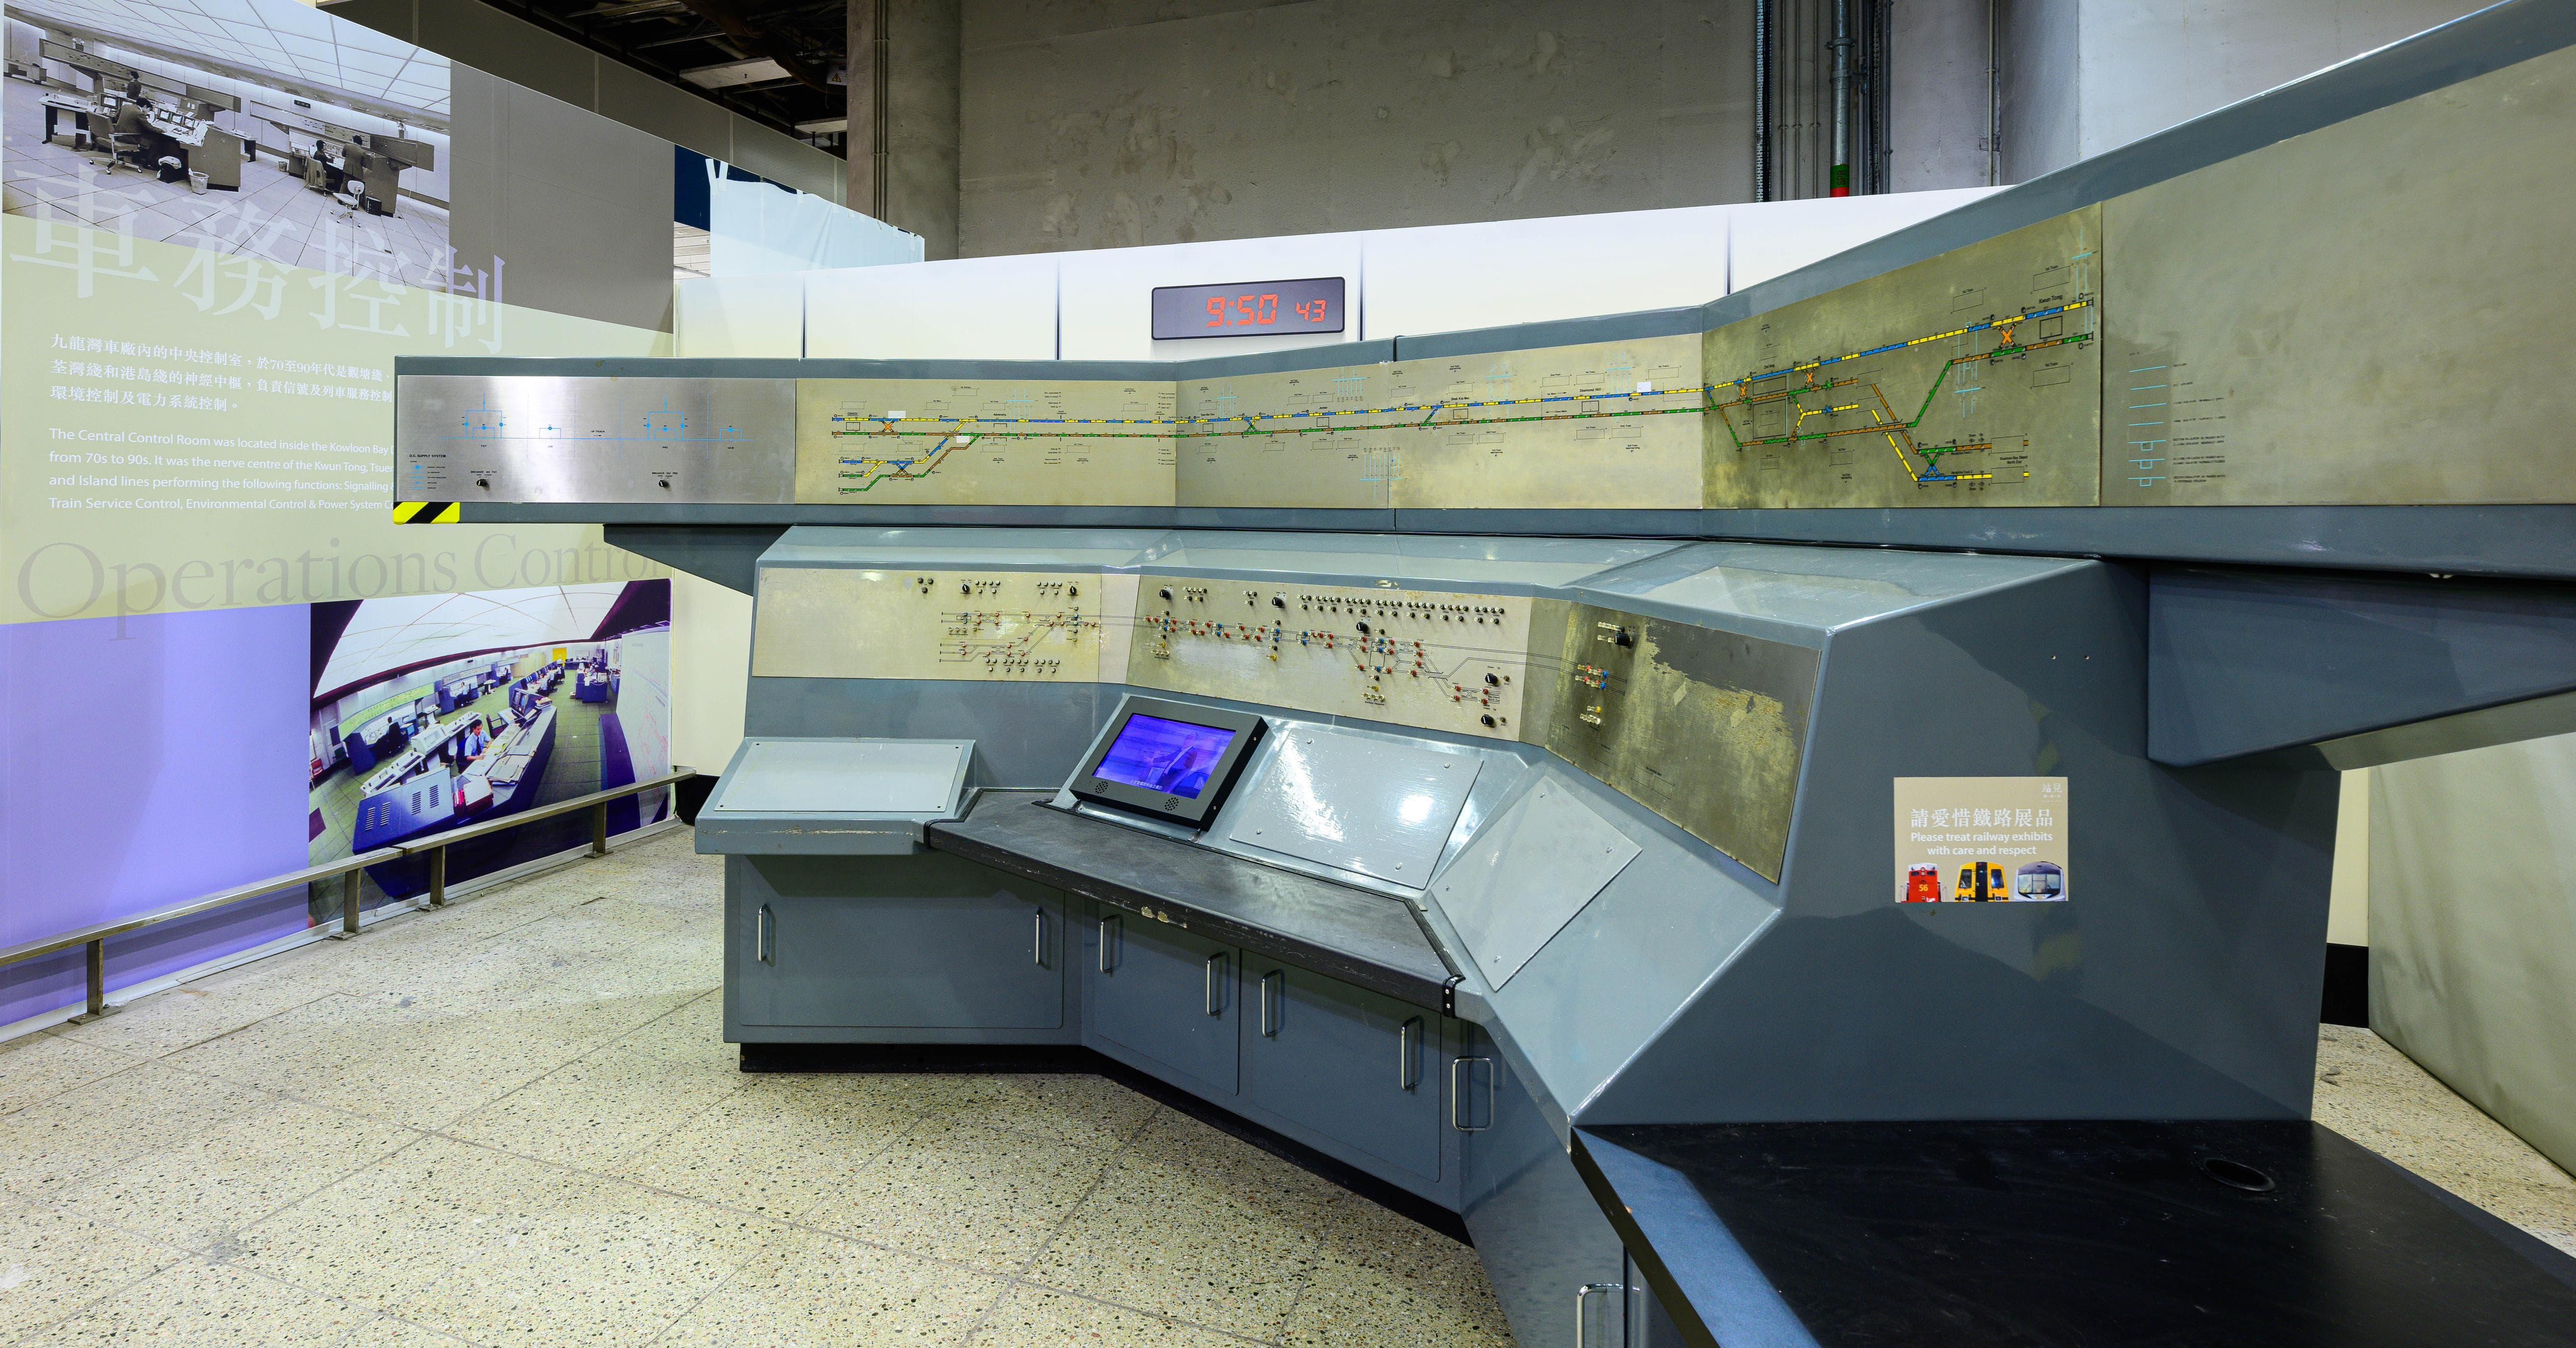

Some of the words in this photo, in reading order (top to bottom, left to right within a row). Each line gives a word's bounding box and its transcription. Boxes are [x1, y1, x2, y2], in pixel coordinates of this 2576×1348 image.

[9, 162, 506, 354] 車務控制
[1207, 294, 1278, 327] 9:50
[1296, 300, 1326, 322] 43
[50, 385, 238, 411] 環境控制及電力系統控制。
[50, 428, 74, 440] The
[78, 430, 124, 442] Central
[128, 432, 173, 444] Control
[177, 435, 210, 446] Room
[213, 439, 234, 447] was
[238, 438, 277, 449] located
[280, 440, 309, 451] inside
[311, 442, 328, 452] the
[330, 443, 370, 453] Kowloon
[373, 444, 388, 456] Bay
[49, 451, 82, 463] from
[86, 453, 108, 464] 70s
[111, 454, 124, 465] to
[128, 454, 151, 465] 90s.
[155, 455, 163, 465] It
[166, 458, 189, 466] was
[192, 456, 210, 467] the
[213, 459, 245, 468] nerve
[248, 460, 280, 469] centre
[283, 460, 294, 470] of
[296, 460, 312, 470] the
[315, 461, 341, 471] Kwun
[344, 462, 368, 474] Tong,
[49, 475, 75, 486] and
[79, 475, 117, 486] Island
[121, 476, 149, 486] lines
[153, 477, 219, 490] performing
[222, 478, 240, 488] the
[243, 478, 291, 491] following
[294, 480, 342, 490] functions:
[344, 481, 388, 492] Signalling
[49, 497, 82, 509] Train
[86, 498, 132, 509] Service
[135, 498, 183, 510] Control,
[186, 498, 266, 509] Environmental
[269, 499, 306, 509] Control
[309, 500, 316, 509] &
[318, 500, 347, 509] Power
[350, 500, 382, 511] System
[18, 537, 457, 642] Operations
[1910, 808, 2053, 827] 請愛惜鐵路展品
[1911, 832, 1943, 841] Please
[1946, 833, 1970, 841] treat
[1973, 832, 2009, 842] railway
[2013, 832, 2053, 841] exhibits
[1927, 846, 1950, 855] with
[1976, 846, 1996, 855] and
[1999, 846, 2037, 857] respect
